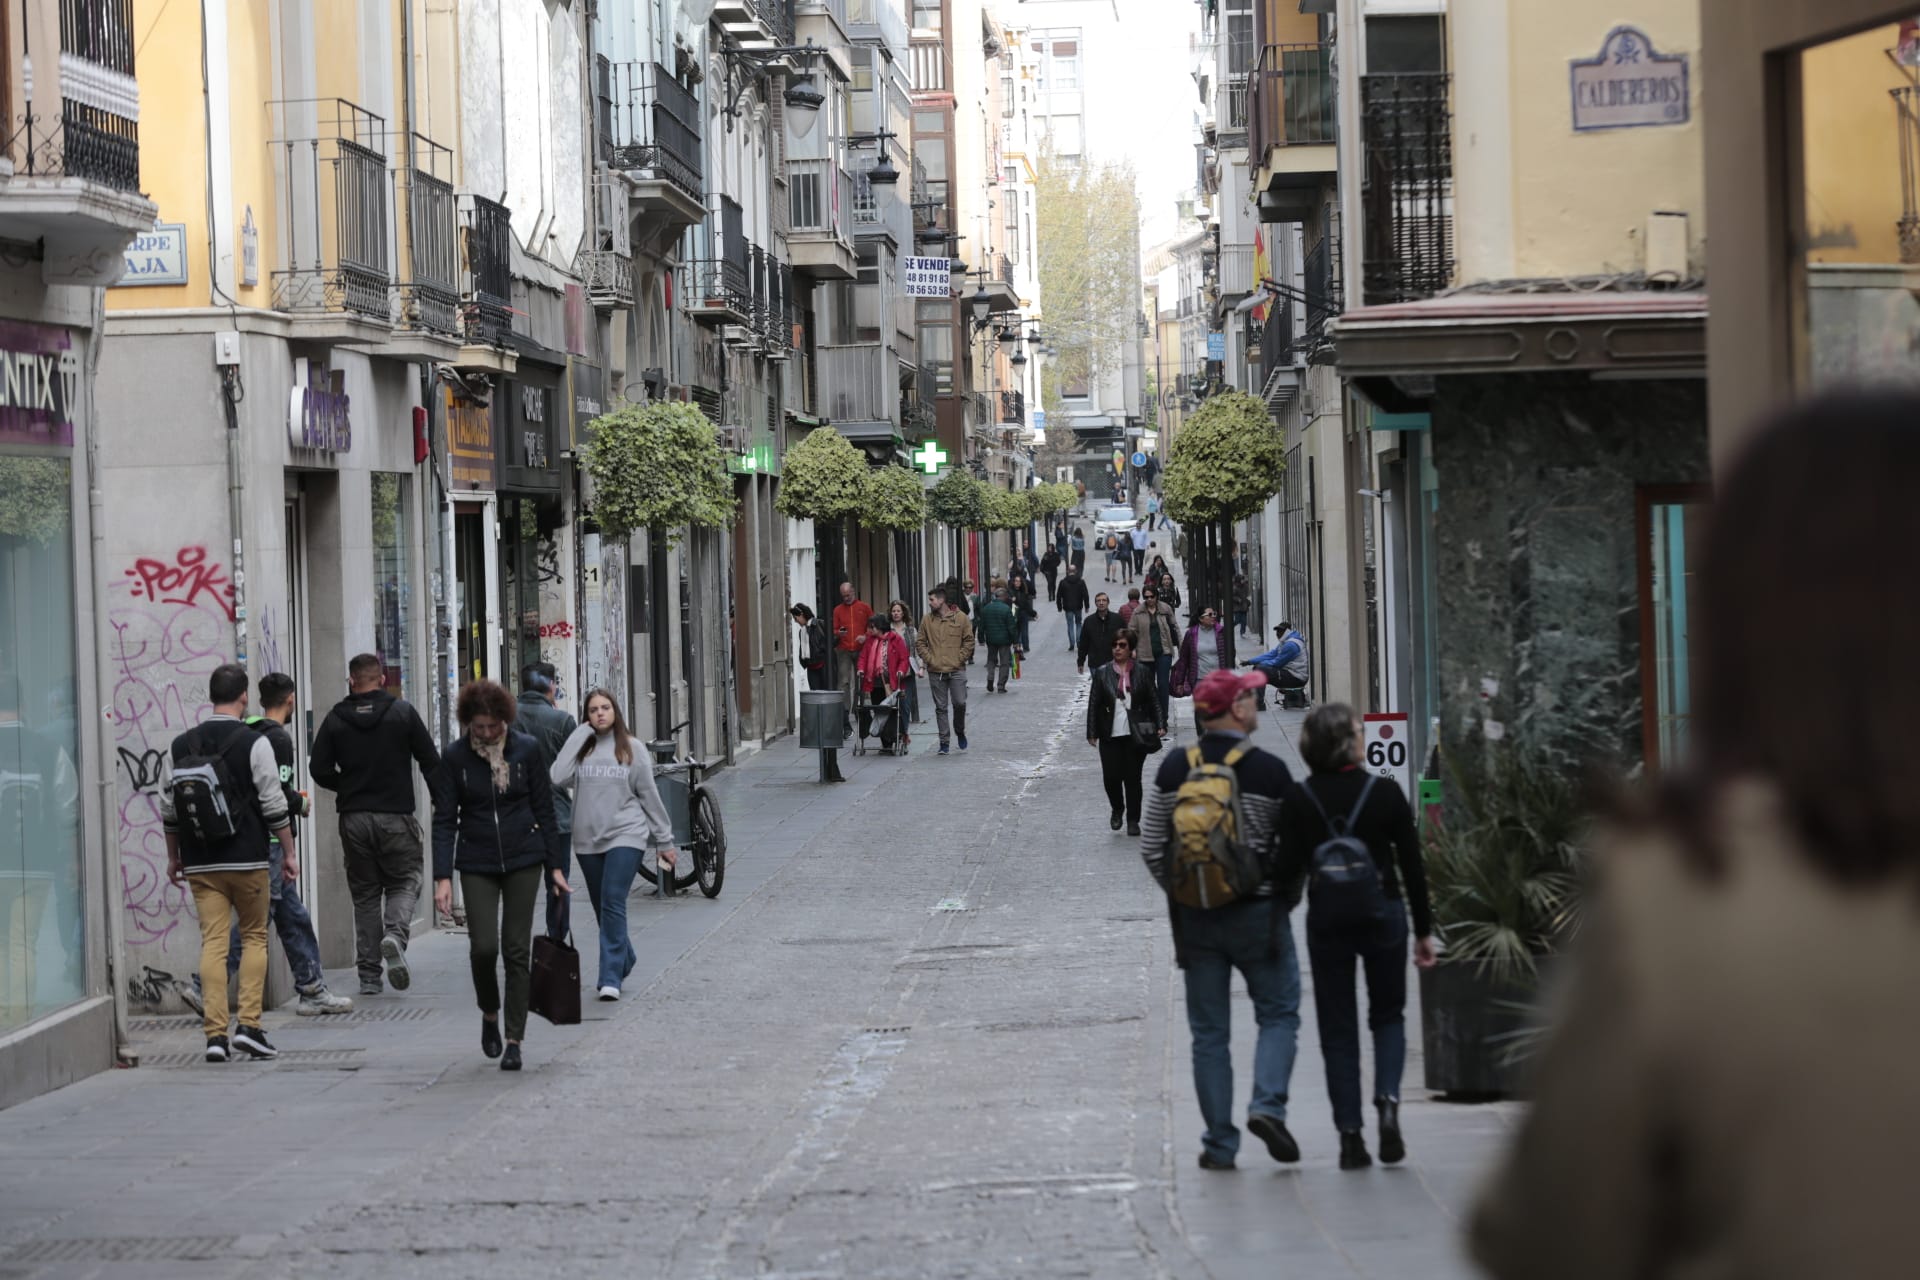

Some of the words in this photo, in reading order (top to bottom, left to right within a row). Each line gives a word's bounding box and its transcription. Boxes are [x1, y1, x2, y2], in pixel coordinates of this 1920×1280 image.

[917, 259, 949, 270] VENDE
[916, 285, 926, 295] 56
[1366, 741, 1406, 767] 60
